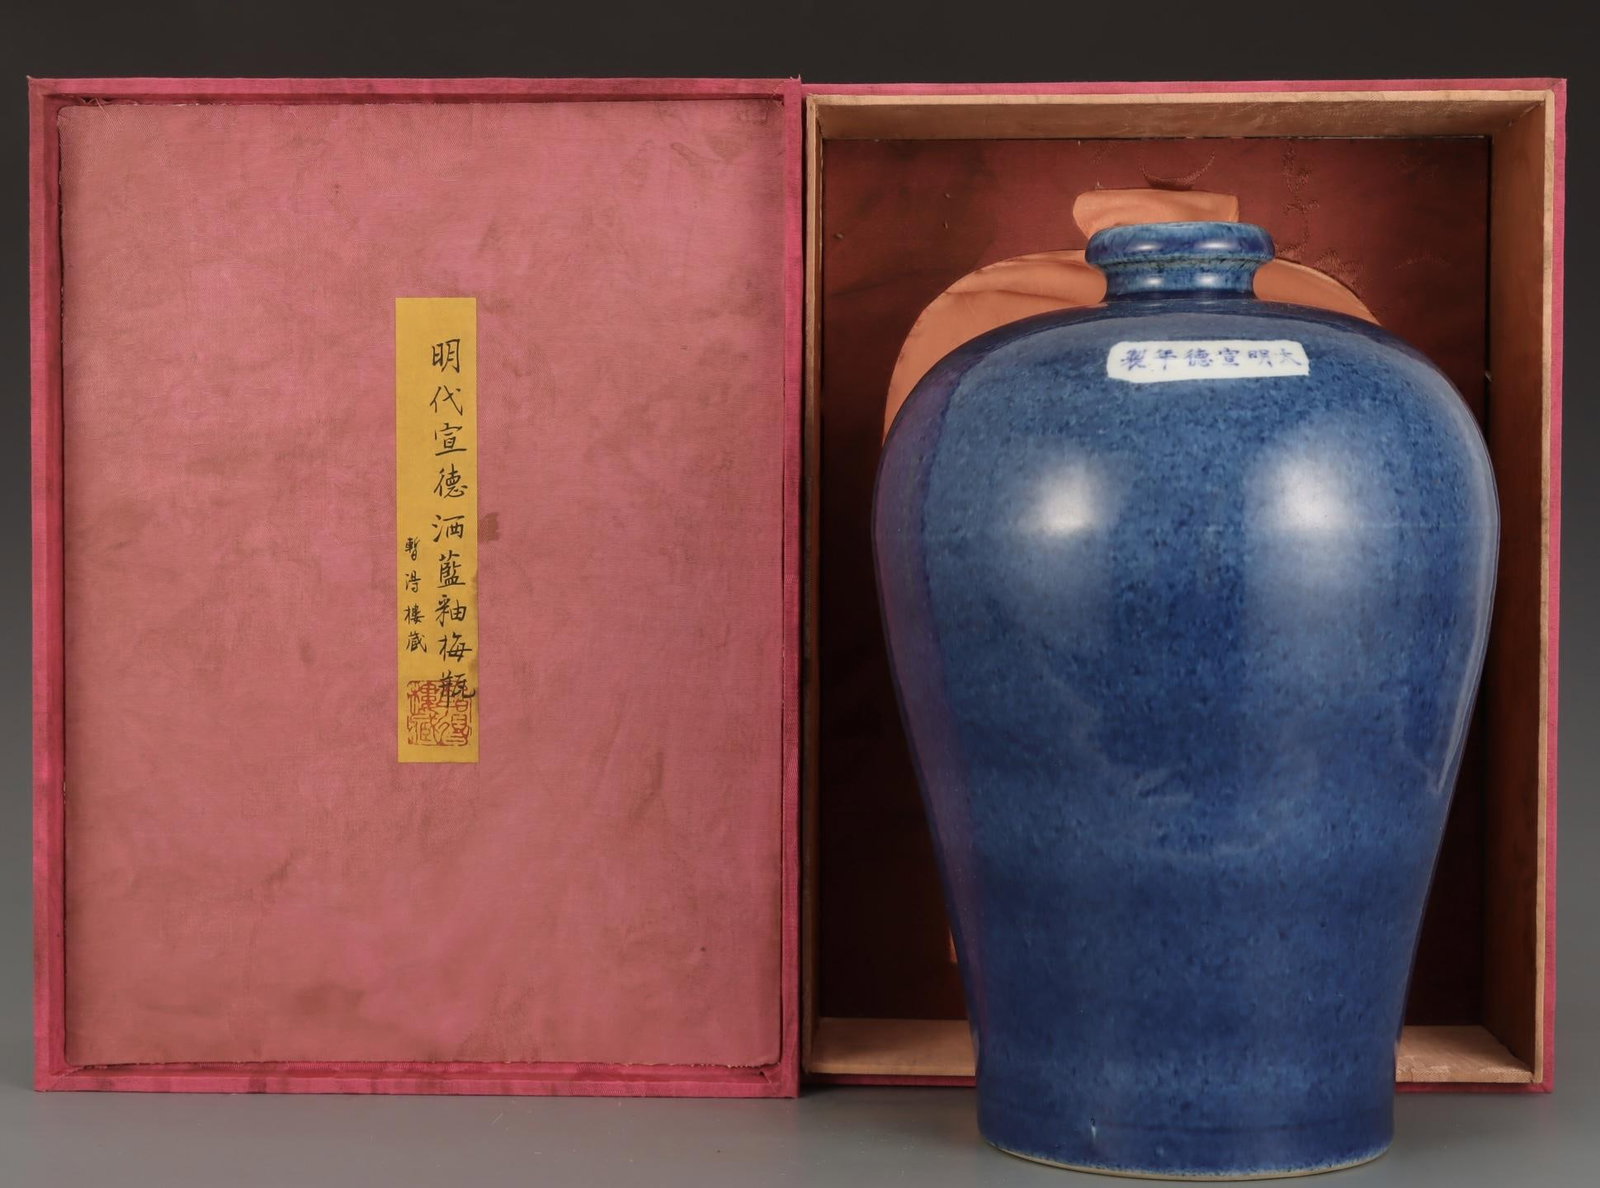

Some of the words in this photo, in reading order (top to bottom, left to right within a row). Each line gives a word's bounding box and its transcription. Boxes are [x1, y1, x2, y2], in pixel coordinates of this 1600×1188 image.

[1120, 347, 1302, 371] 大明宣德年製
